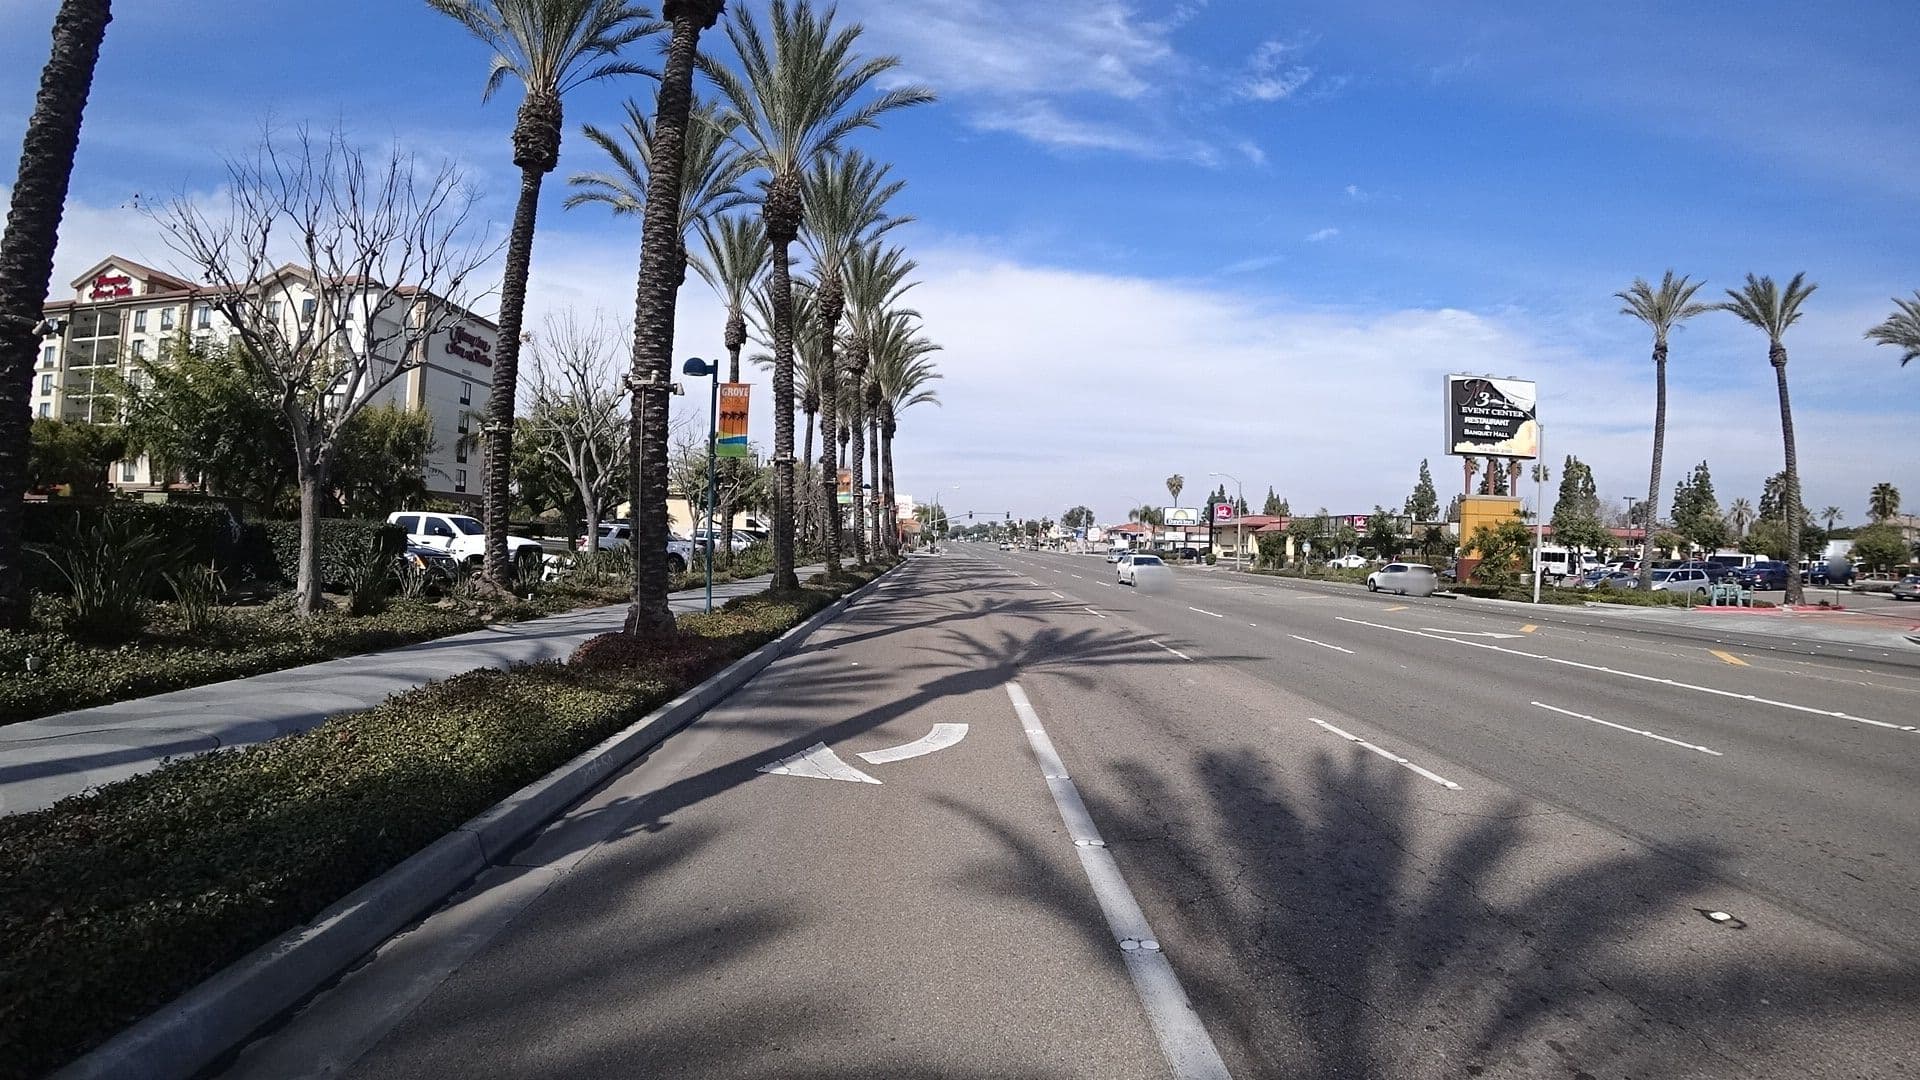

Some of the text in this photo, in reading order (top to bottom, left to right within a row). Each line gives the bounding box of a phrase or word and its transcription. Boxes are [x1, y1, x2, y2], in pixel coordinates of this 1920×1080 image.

[721, 387, 749, 397] GROVE
[1462, 406, 1525, 418] EVENT CENTER
[1464, 417, 1510, 426] RESTAURANT
